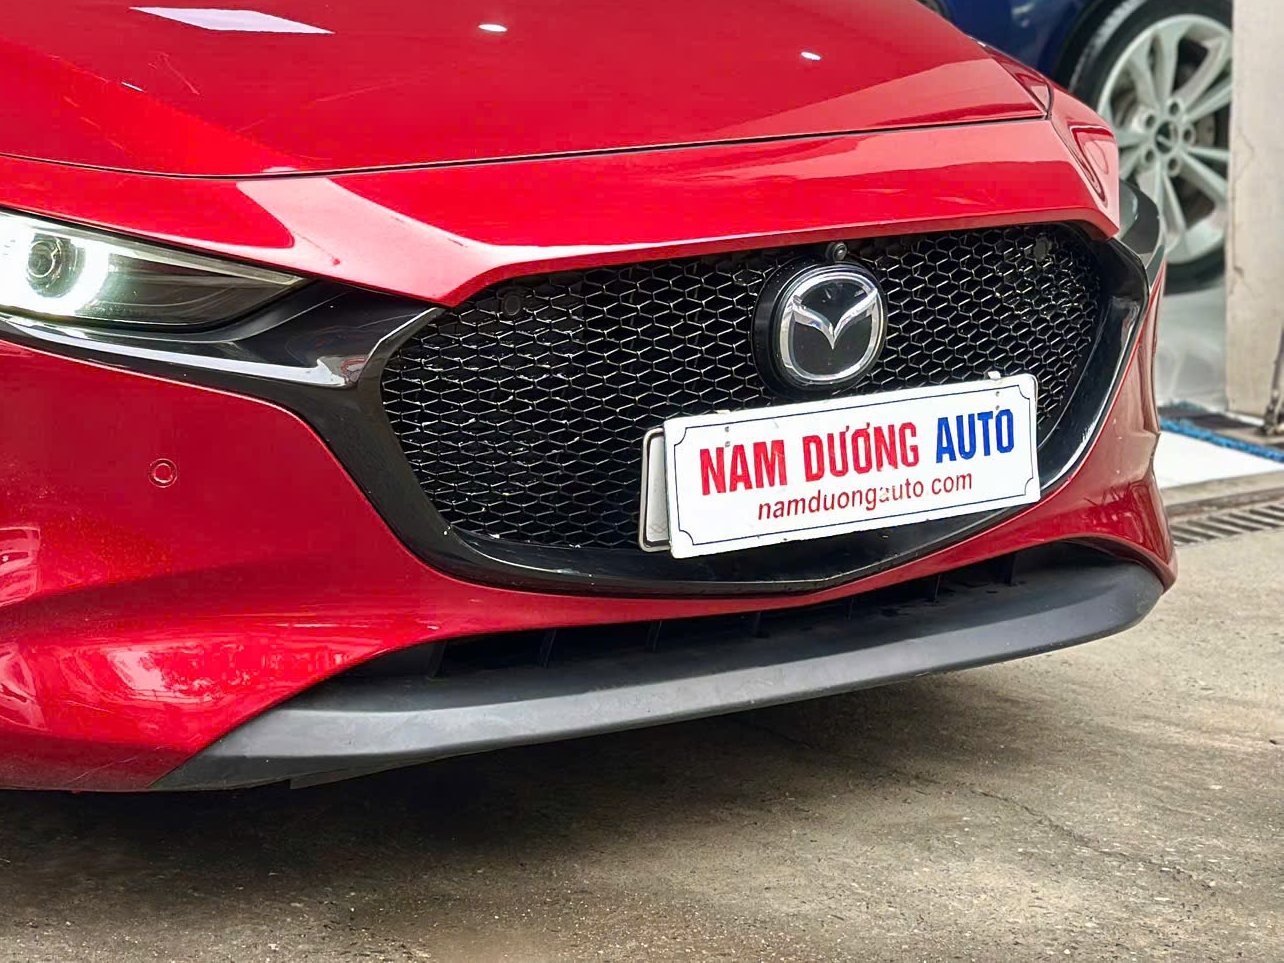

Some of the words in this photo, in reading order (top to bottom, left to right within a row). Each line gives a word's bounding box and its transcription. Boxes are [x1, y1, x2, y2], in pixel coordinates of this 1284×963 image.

[699, 439, 788, 496] NAM
[802, 422, 920, 483] DƯƠNG
[935, 408, 1016, 464] AUTO
